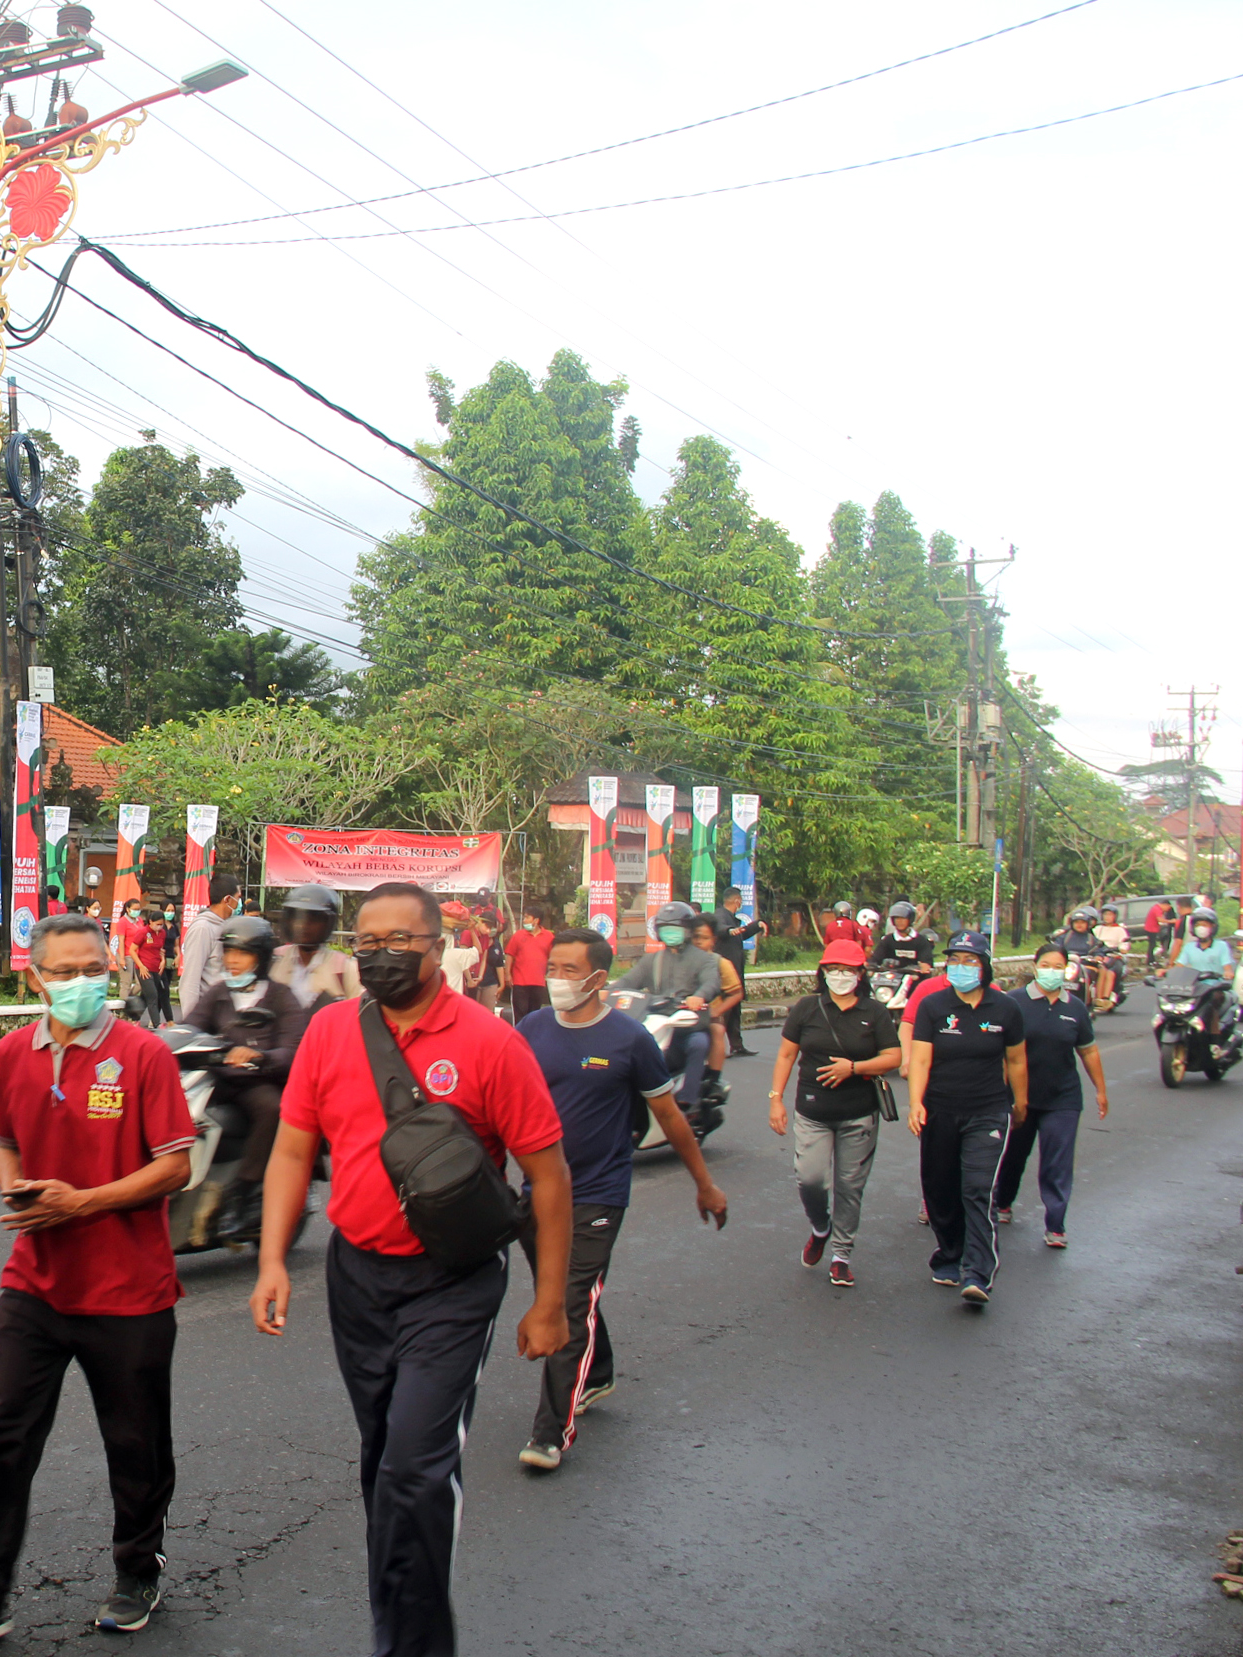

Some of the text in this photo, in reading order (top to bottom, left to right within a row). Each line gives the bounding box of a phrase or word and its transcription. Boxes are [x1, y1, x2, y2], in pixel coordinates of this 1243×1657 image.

[302, 842, 460, 859] ZONA INTEGRITAS
[302, 859, 462, 872] WILAYAH BEBAS KORUPSI
[431, 1073, 453, 1085] SPI
[87, 1089, 124, 1109] RSJ
